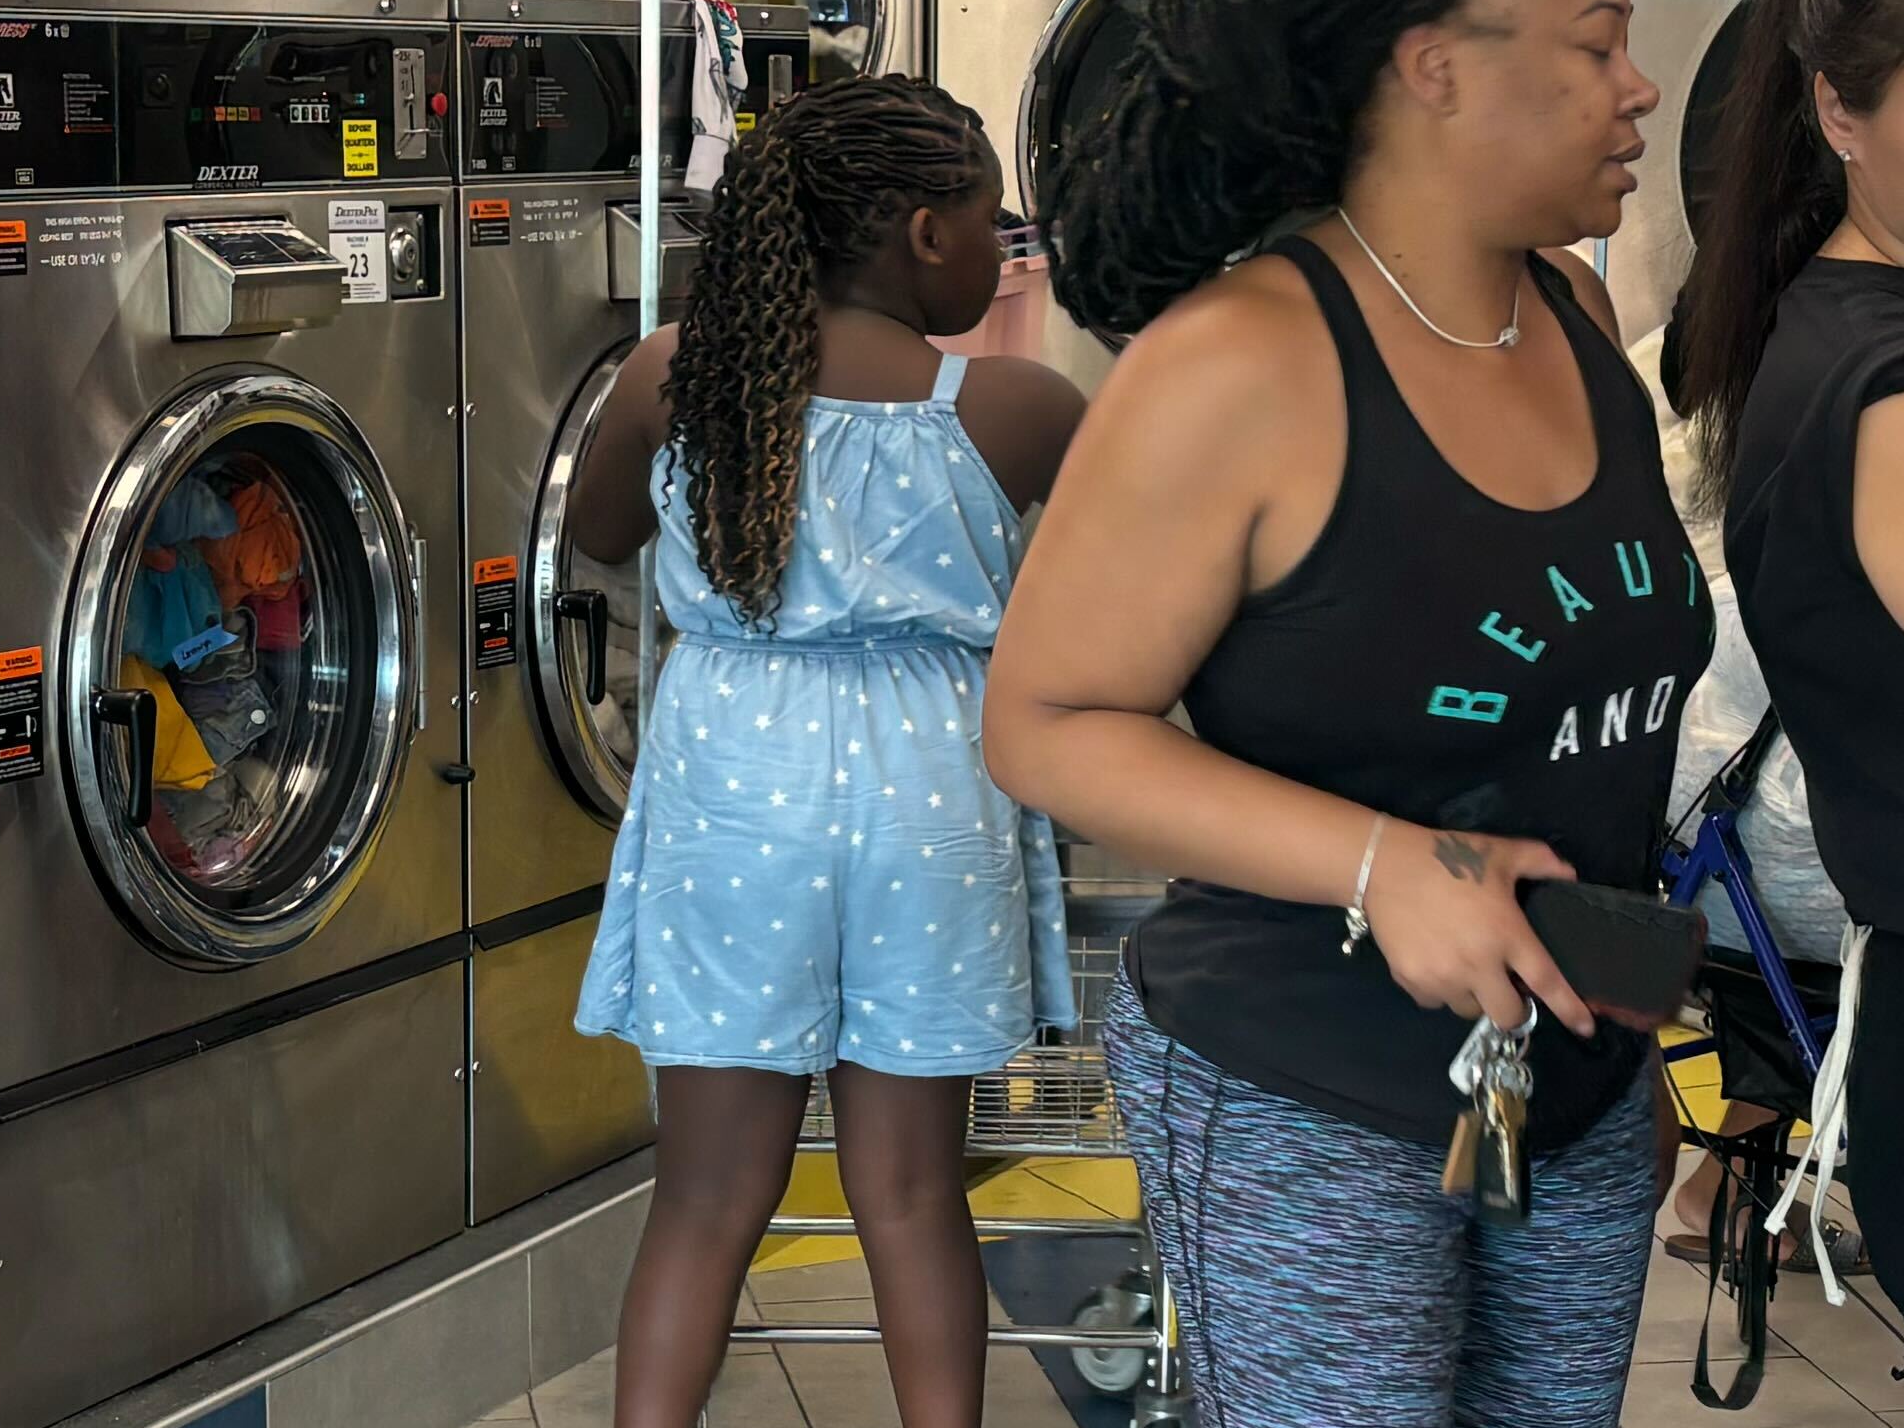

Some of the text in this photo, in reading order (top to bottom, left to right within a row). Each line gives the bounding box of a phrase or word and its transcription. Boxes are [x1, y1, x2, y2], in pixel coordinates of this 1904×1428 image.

[45, 23, 53, 38] 6
[196, 165, 258, 181] DEXTER
[50, 255, 66, 267] USE
[349, 253, 369, 278] 23
[1549, 675, 1676, 762] AND
